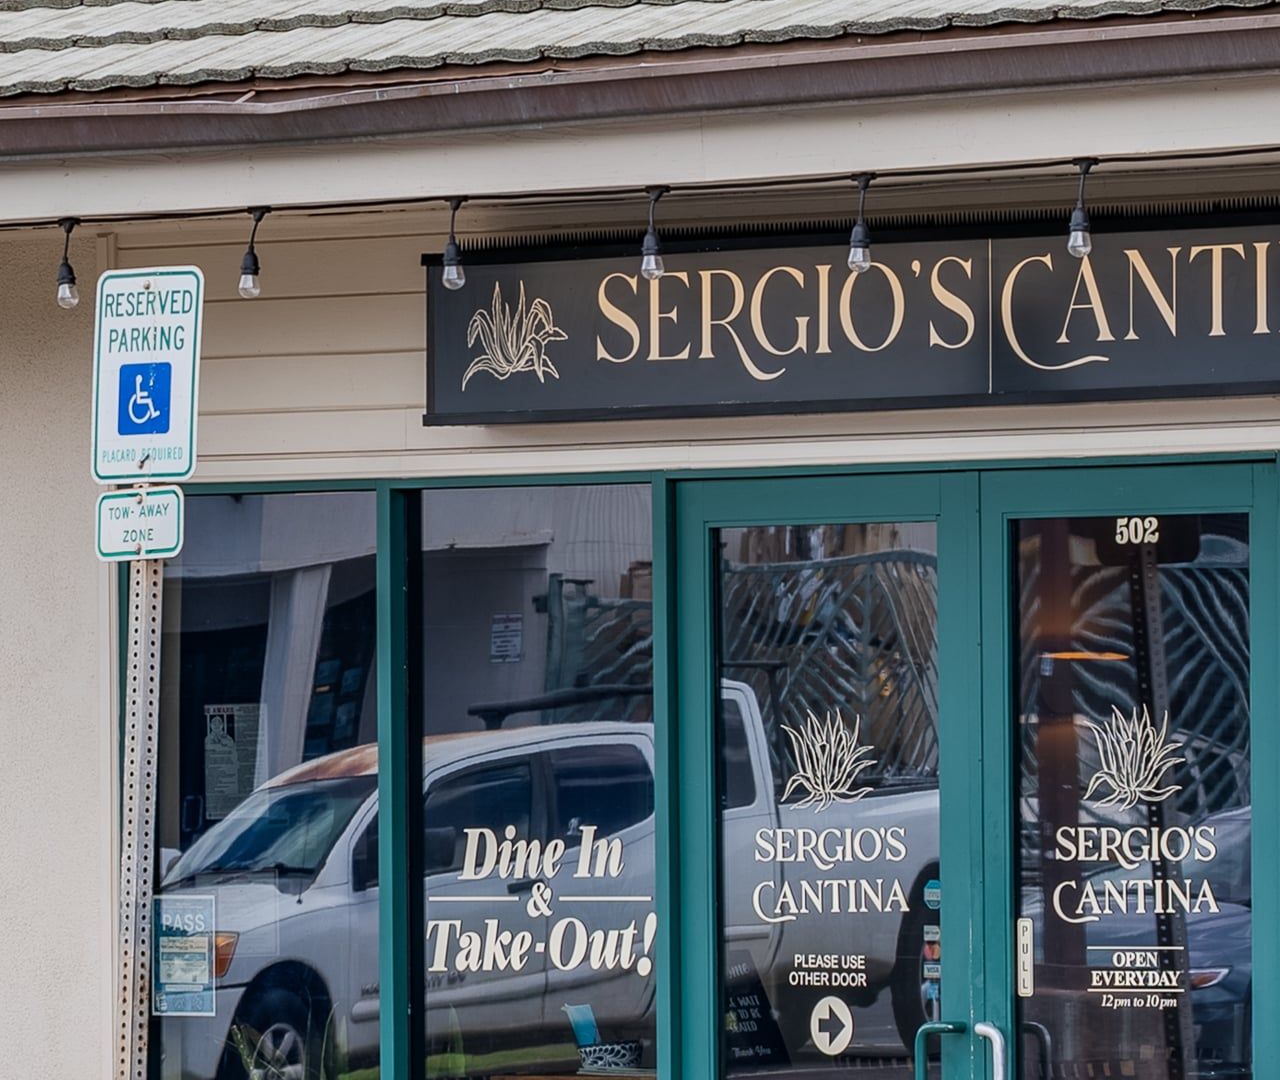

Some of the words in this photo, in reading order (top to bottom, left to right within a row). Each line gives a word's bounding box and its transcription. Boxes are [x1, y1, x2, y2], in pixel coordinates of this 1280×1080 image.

[104, 289, 193, 318] RESERVED
[596, 256, 975, 381] SERGIO'S
[108, 324, 185, 354] PARKING
[102, 448, 136, 463] PLACARD
[141, 447, 183, 462] REQUIRED
[138, 503, 170, 518] AWAY
[122, 528, 154, 543] ZONE
[1115, 516, 1159, 544] 502
[457, 824, 565, 880] Dine
[573, 825, 625, 878] In
[754, 827, 907, 871] SERGIO'S
[1054, 825, 1217, 870] SERGIO'S
[526, 881, 553, 918] &
[752, 878, 910, 923] CANTINA
[1052, 878, 1220, 923] CANTINA
[162, 913, 205, 932] PASS
[426, 912, 657, 977] Take-Out!
[794, 953, 839, 968] PLEASE
[841, 954, 866, 969] USE
[1112, 951, 1158, 967] OPEN
[788, 971, 829, 986] OTHER
[831, 972, 867, 987] DOOR
[1090, 970, 1180, 987] EVERYDAY
[1133, 995, 1144, 1007] to
